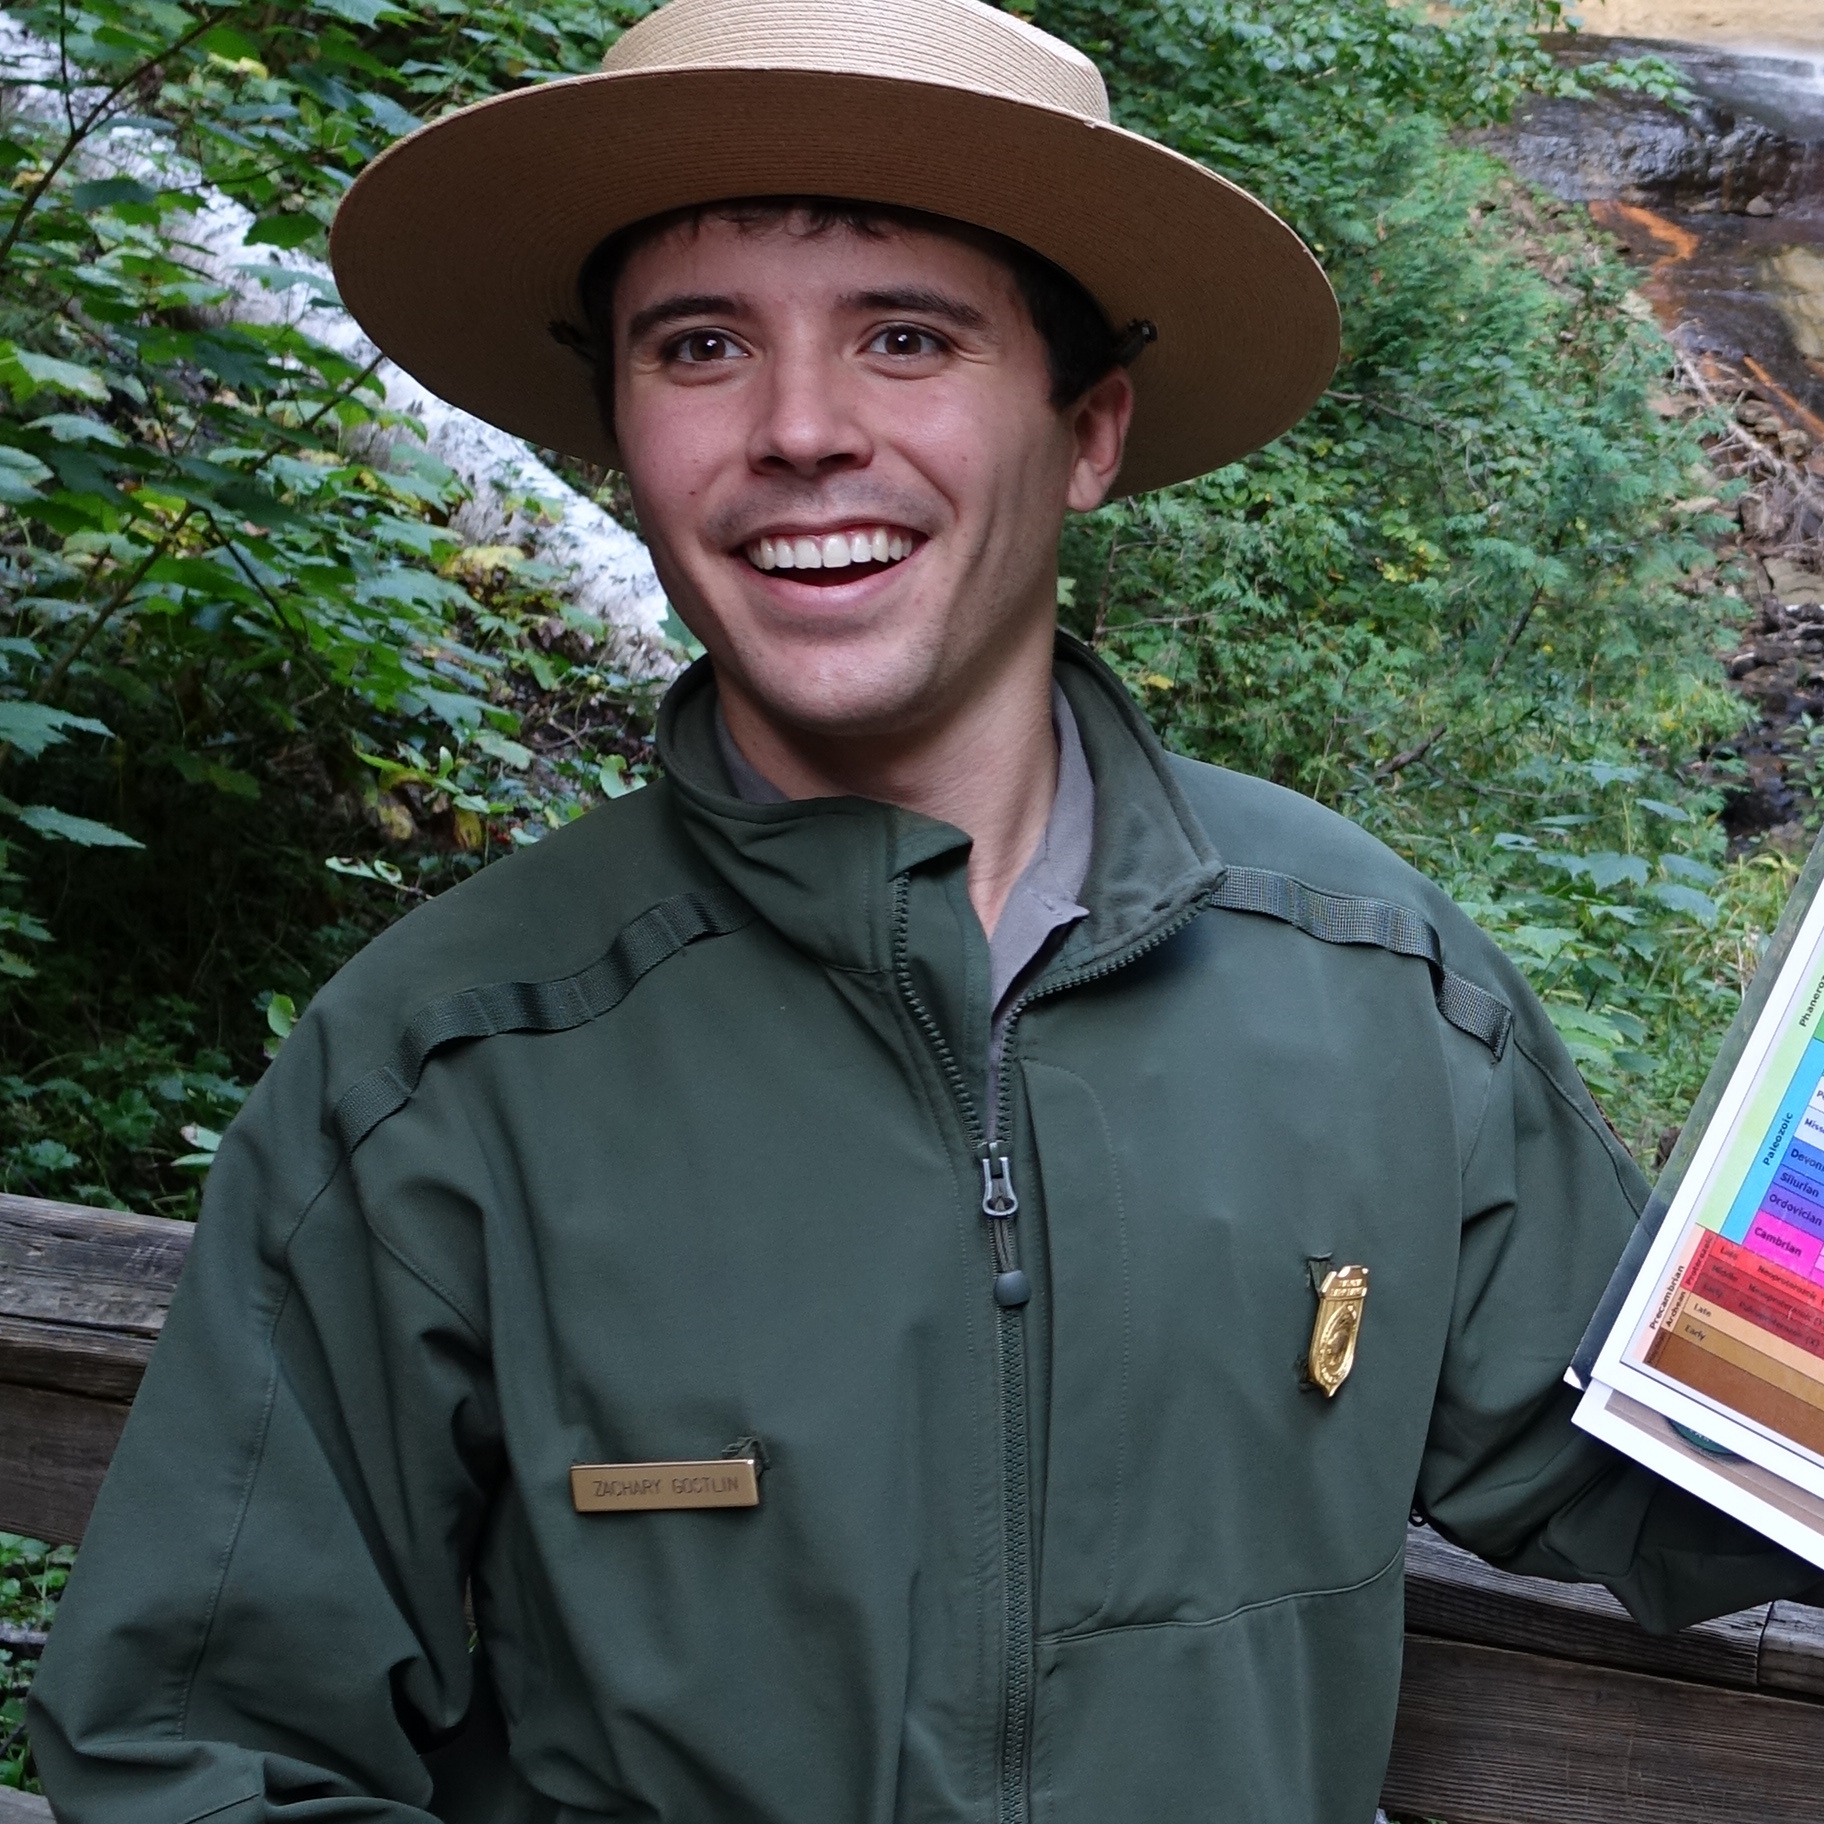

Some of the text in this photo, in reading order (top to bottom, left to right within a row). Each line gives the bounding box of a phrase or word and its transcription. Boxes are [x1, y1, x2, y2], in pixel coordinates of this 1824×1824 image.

[1761, 1110, 1793, 1167] Paleozoic
[1778, 1170, 1821, 1198] Silurian
[1767, 1192, 1824, 1227] Ordovician
[1752, 1225, 1803, 1257] Cambrian
[1685, 1234, 1714, 1286] Proterozoic
[1648, 1263, 1685, 1331] Precambrian
[1664, 1289, 1686, 1327] Archean
[1692, 1302, 1712, 1318] Late
[1683, 1323, 1707, 1342] Early
[593, 1479, 662, 1497] ZACHARY
